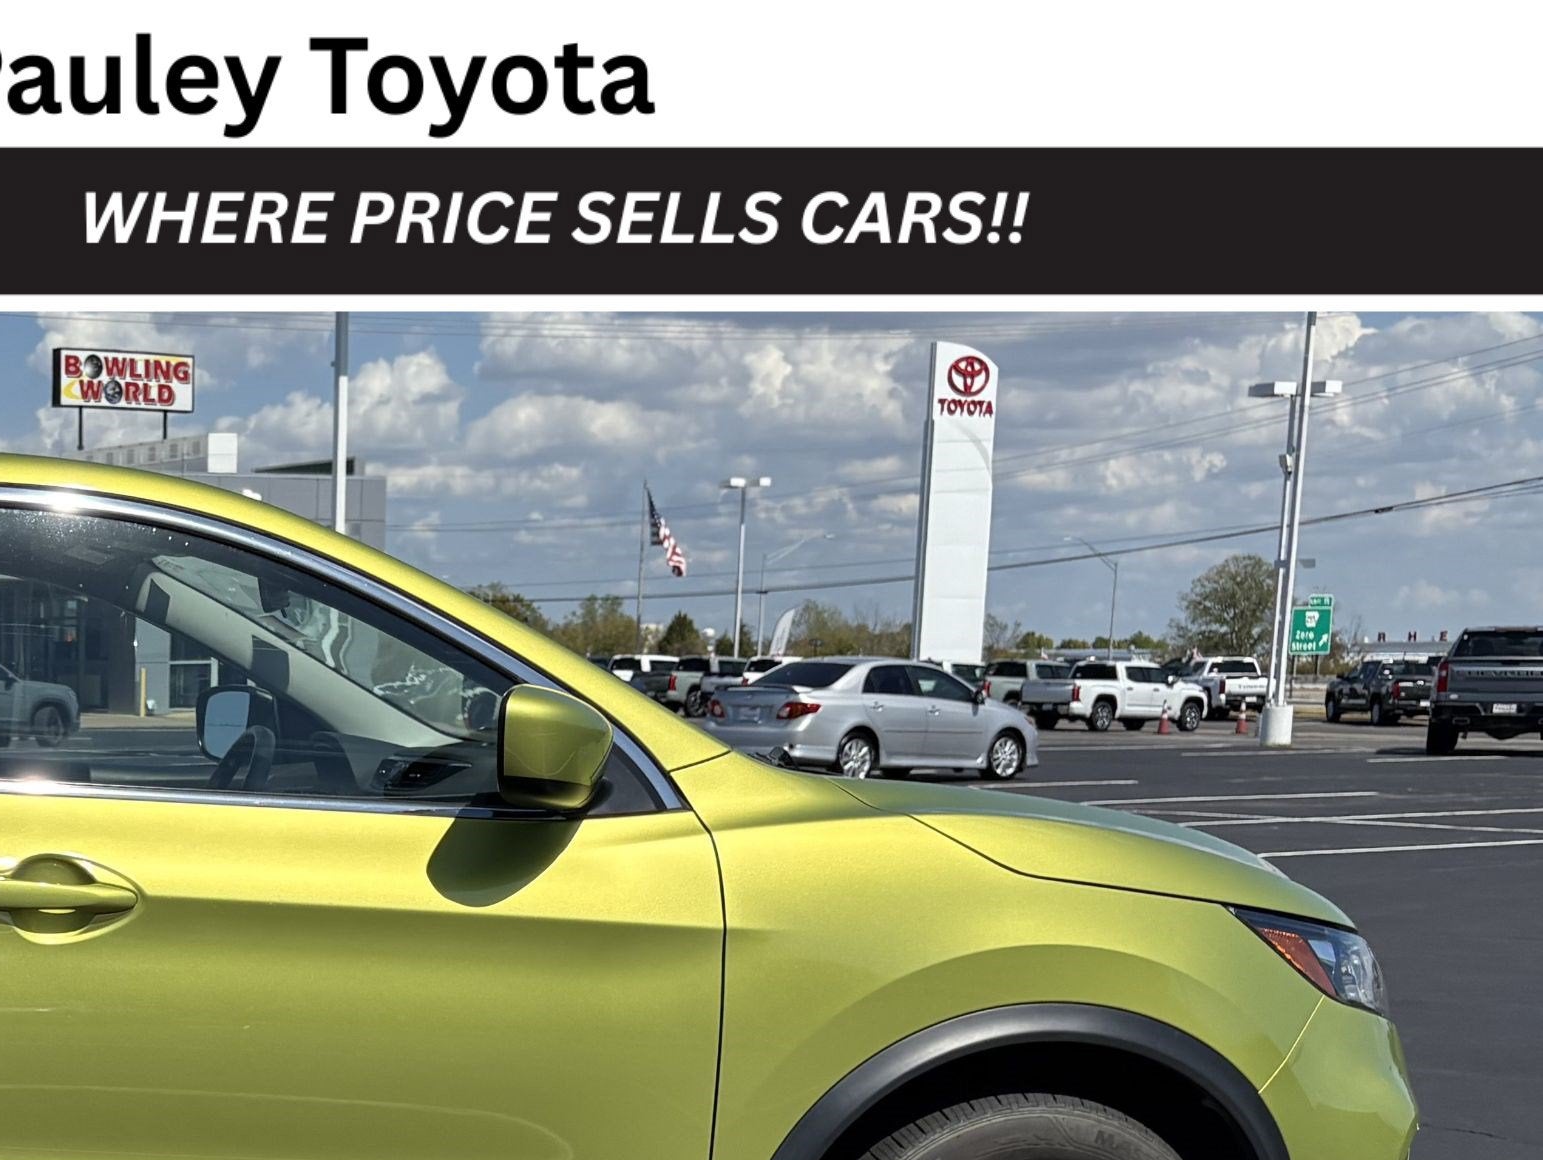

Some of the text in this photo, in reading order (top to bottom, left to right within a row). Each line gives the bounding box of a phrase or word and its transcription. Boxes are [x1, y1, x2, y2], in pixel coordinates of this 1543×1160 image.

[64, 354, 190, 384] BOWLING
[79, 379, 175, 405] WORLD
[938, 399, 993, 417] TOYOTA
